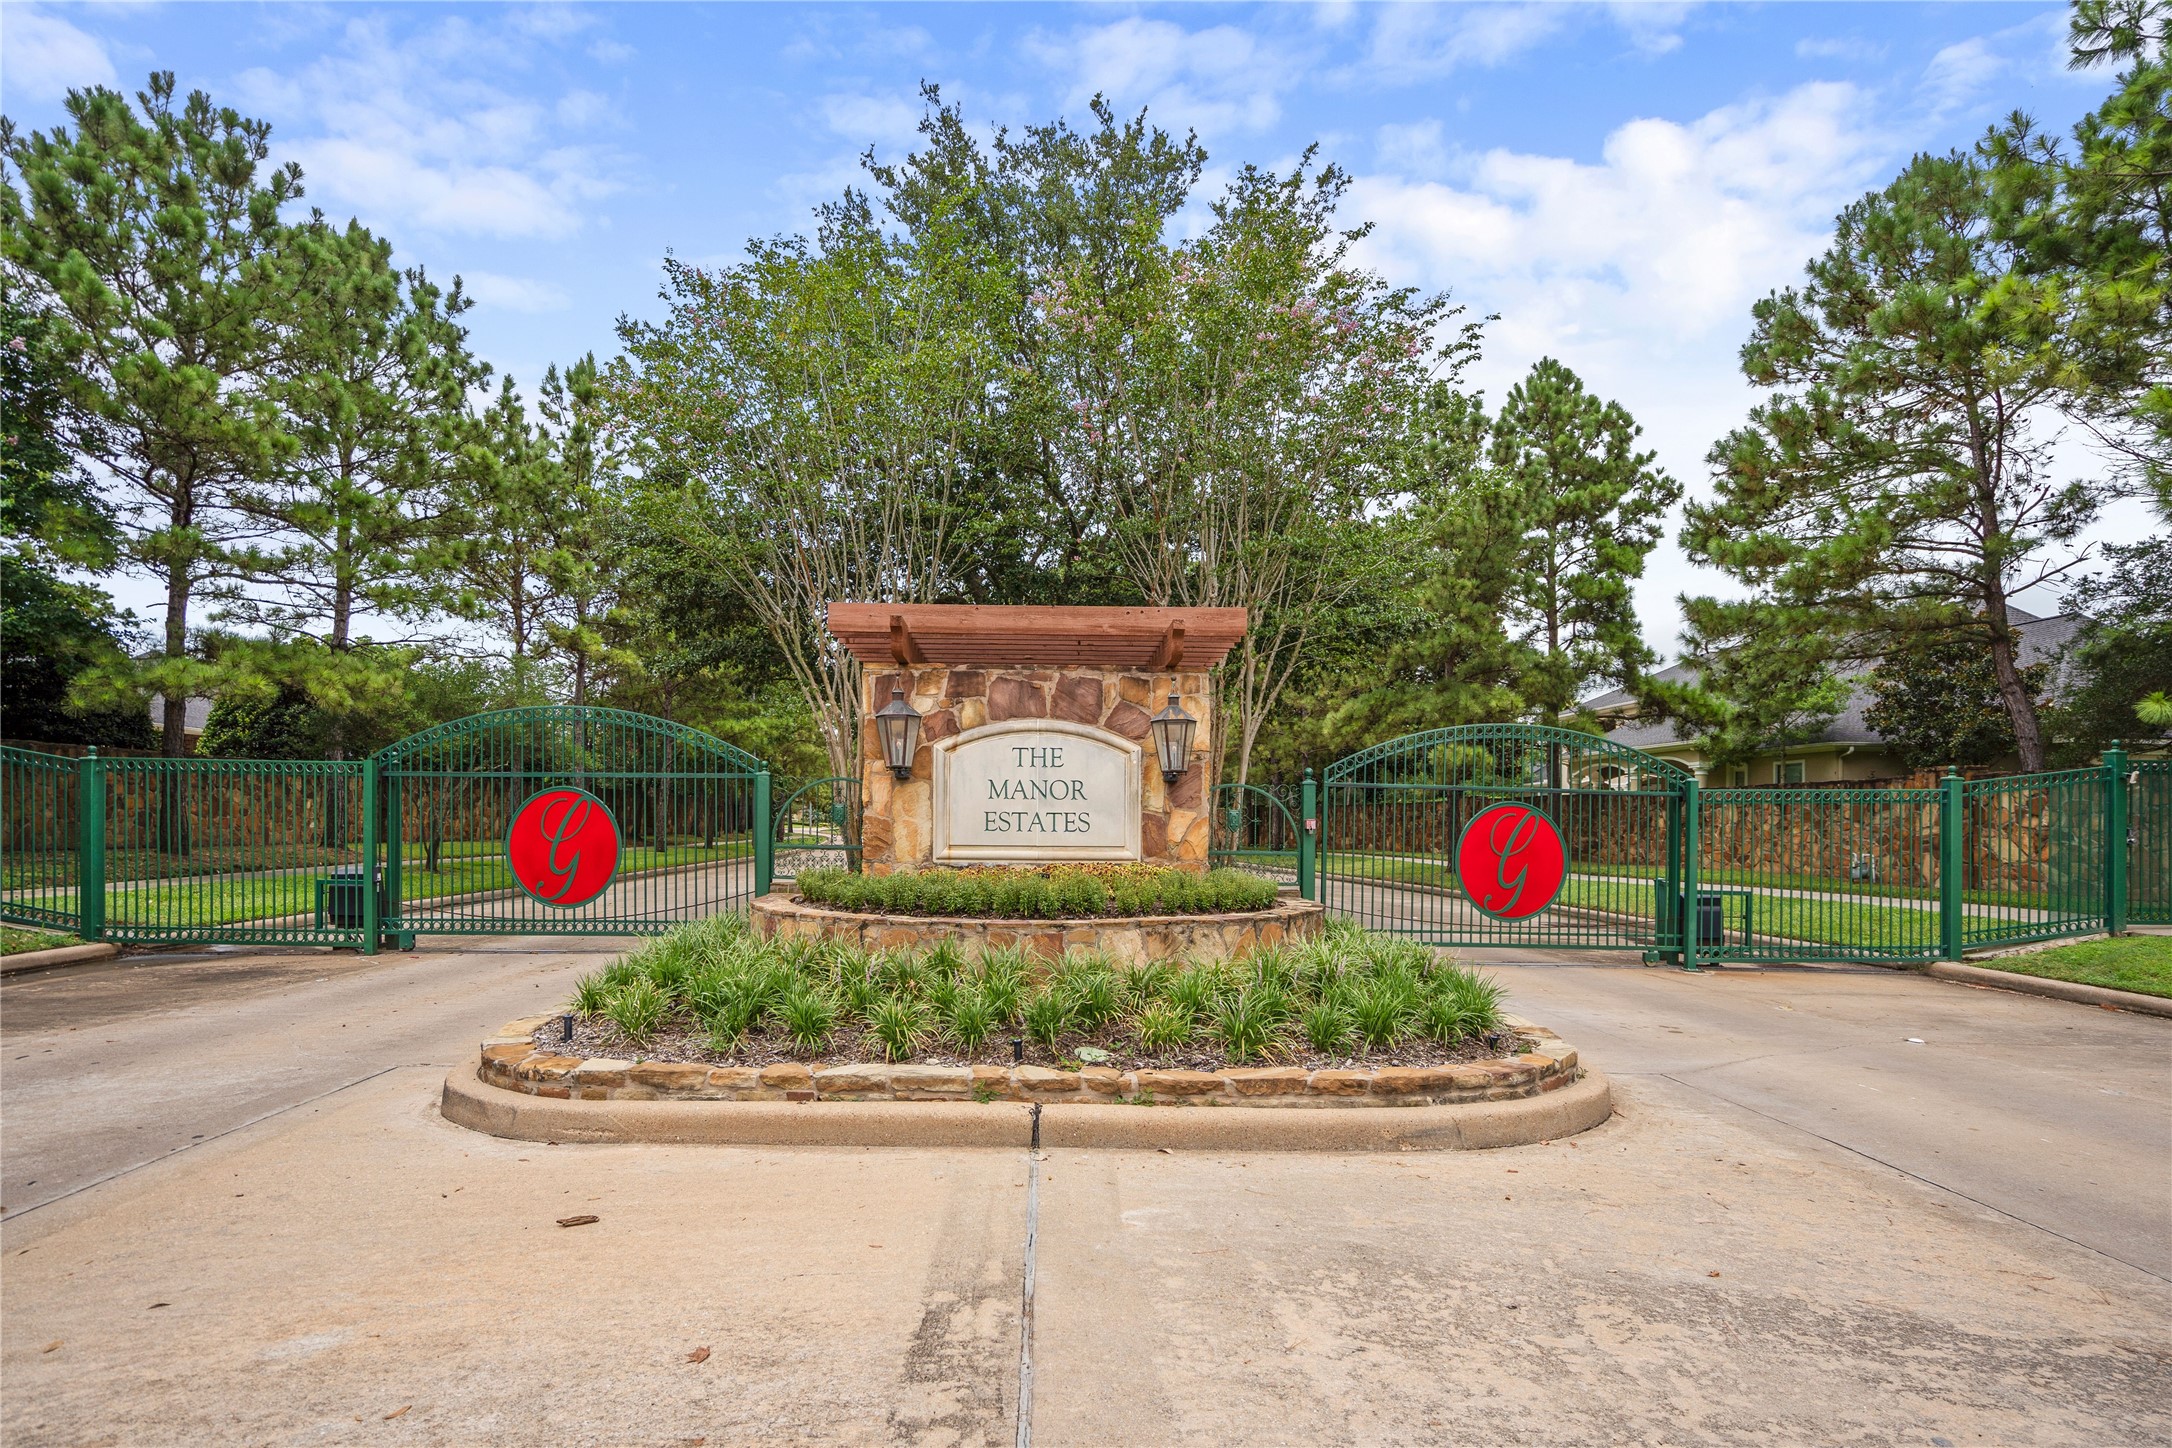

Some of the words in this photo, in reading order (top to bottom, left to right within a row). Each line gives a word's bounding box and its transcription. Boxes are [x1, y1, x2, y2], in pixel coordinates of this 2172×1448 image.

[1012, 747, 1065, 768] THE
[988, 779, 1088, 801] MANOR
[984, 811, 1091, 833] ESTATES
[536, 795, 592, 901] G
[1484, 810, 1540, 914] G
